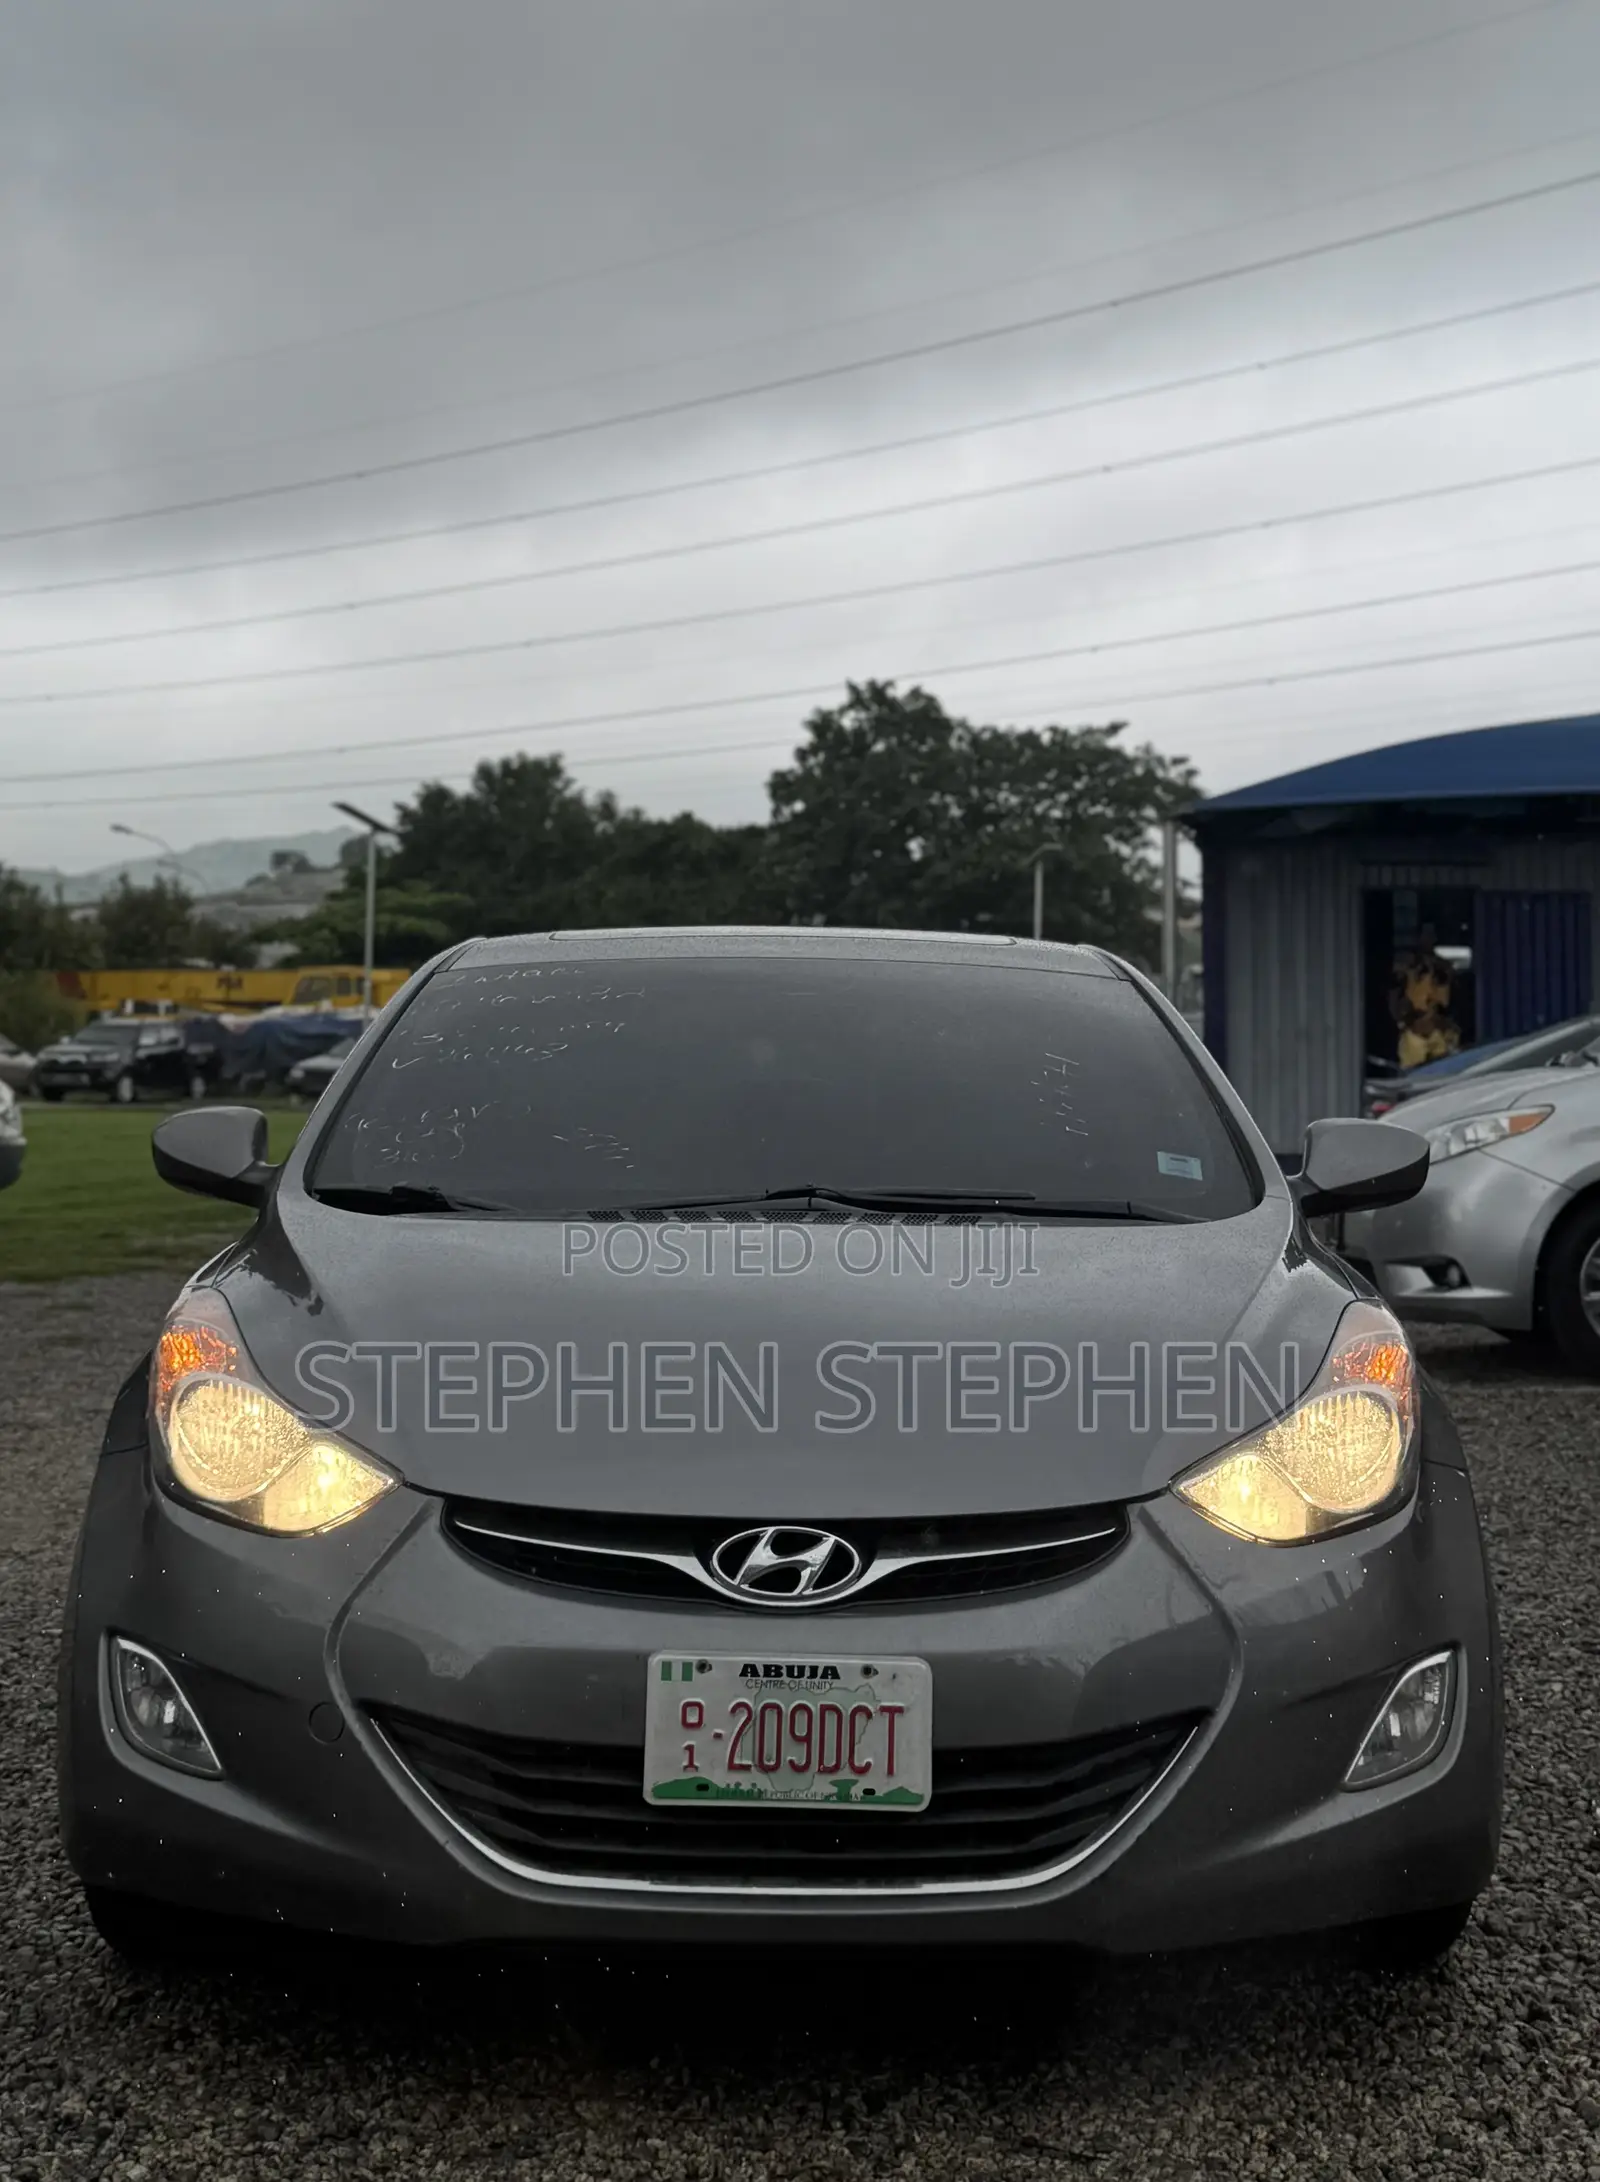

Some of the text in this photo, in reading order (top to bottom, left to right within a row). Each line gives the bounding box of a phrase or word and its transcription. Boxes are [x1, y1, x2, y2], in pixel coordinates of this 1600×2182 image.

[739, 1663, 841, 1680] ABUJA
[745, 1679, 785, 1690] CENTRE
[804, 1680, 834, 1690] UNITY
